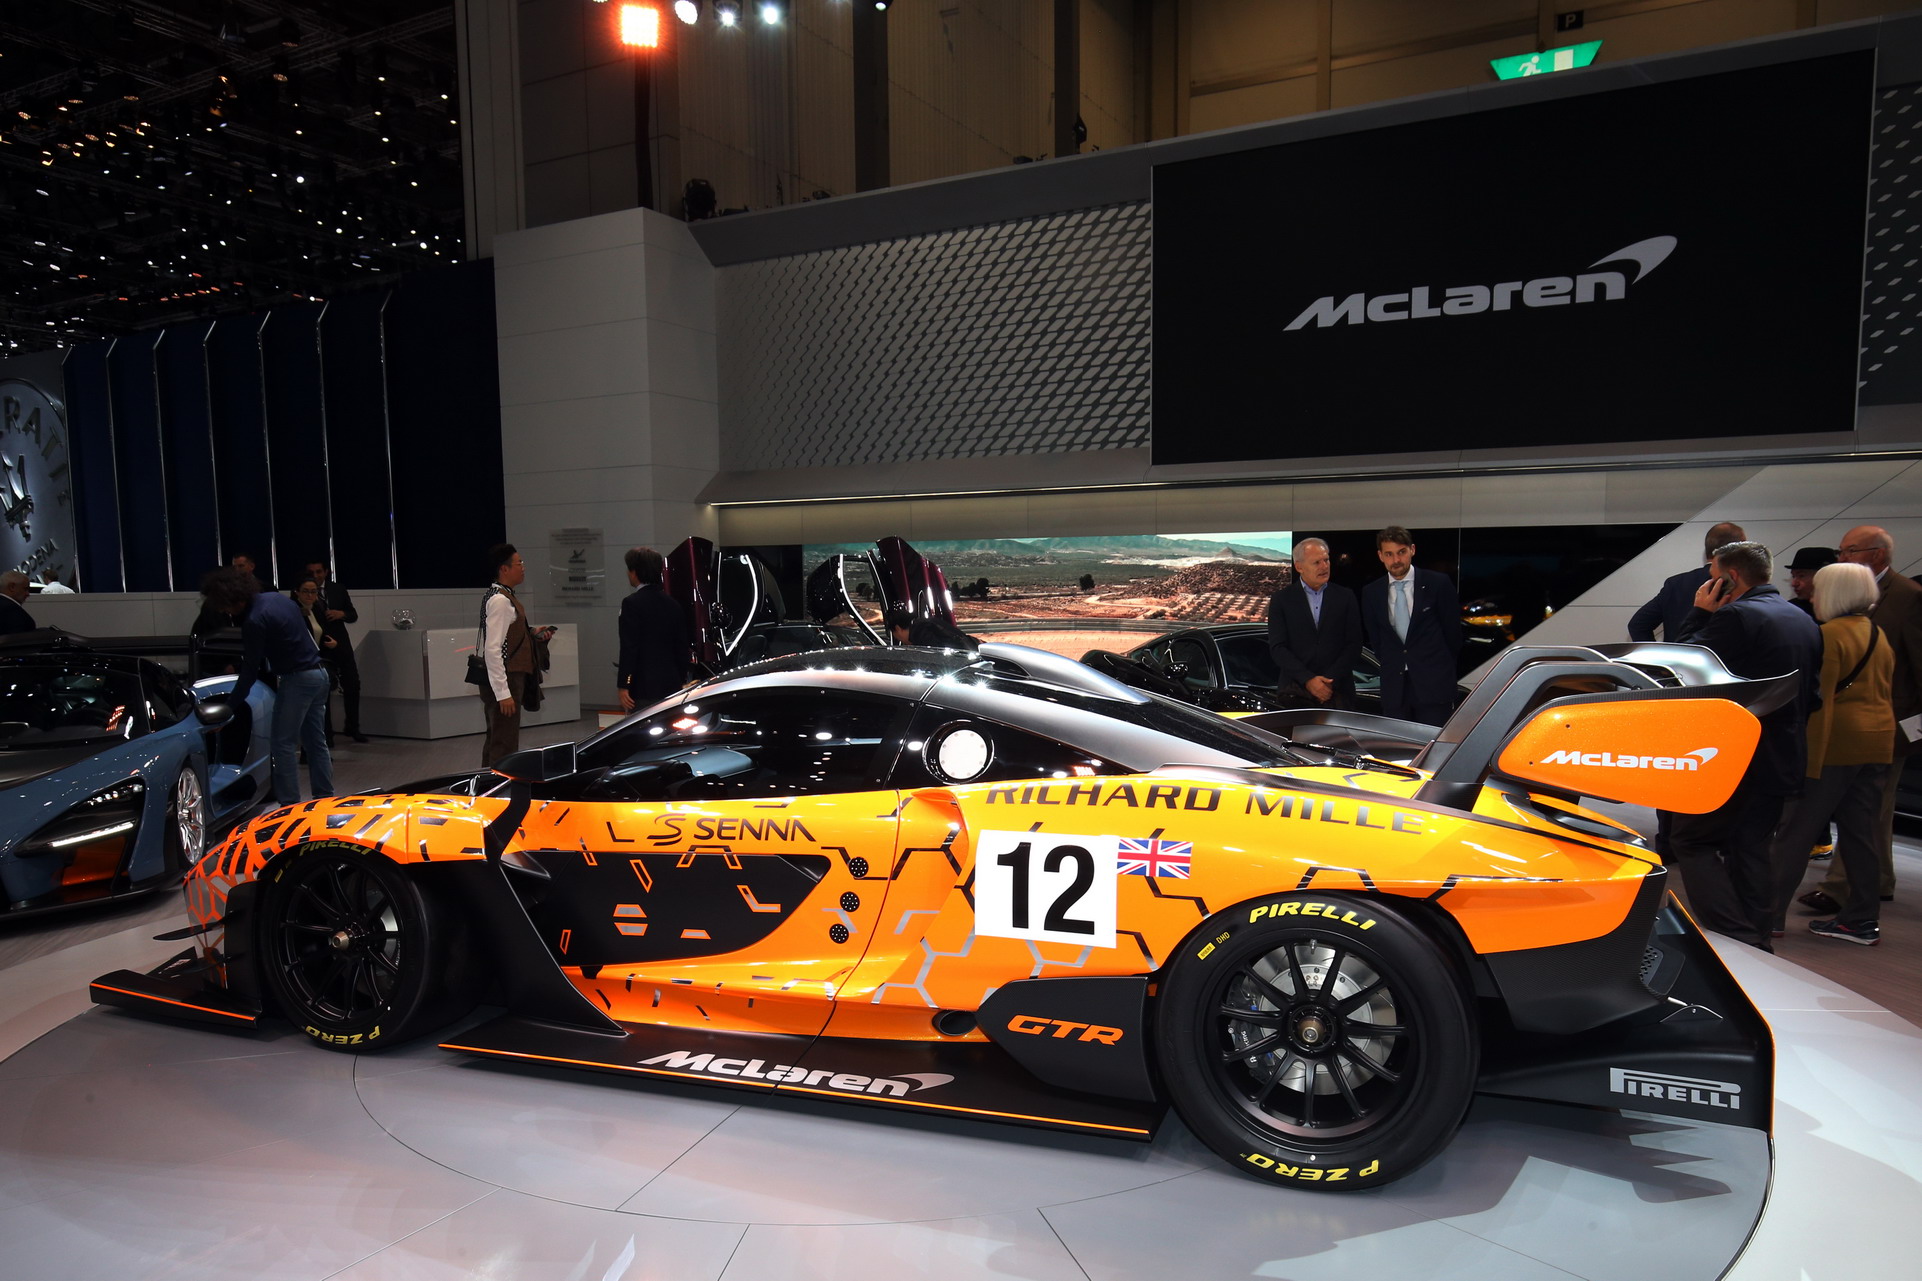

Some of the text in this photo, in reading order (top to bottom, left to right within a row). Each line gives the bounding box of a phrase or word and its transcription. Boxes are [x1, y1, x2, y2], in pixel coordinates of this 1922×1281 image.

[1566, 14, 1579, 28] P
[1283, 269, 1628, 332] McLaren
[0, 396, 68, 481] RATI
[1540, 748, 1699, 772] McLaren
[986, 783, 1424, 836] RICHARD MILLE
[694, 817, 817, 843] SENNA
[997, 842, 1096, 936] 12
[1249, 902, 1377, 931] PIRELLI
[305, 1025, 381, 1045] P ZERO
[1006, 1014, 1125, 1046] GTR
[637, 1049, 912, 1098] McLaren
[1609, 1067, 1741, 1110] PIRELLI
[1246, 1153, 1380, 1182] P ZERO
